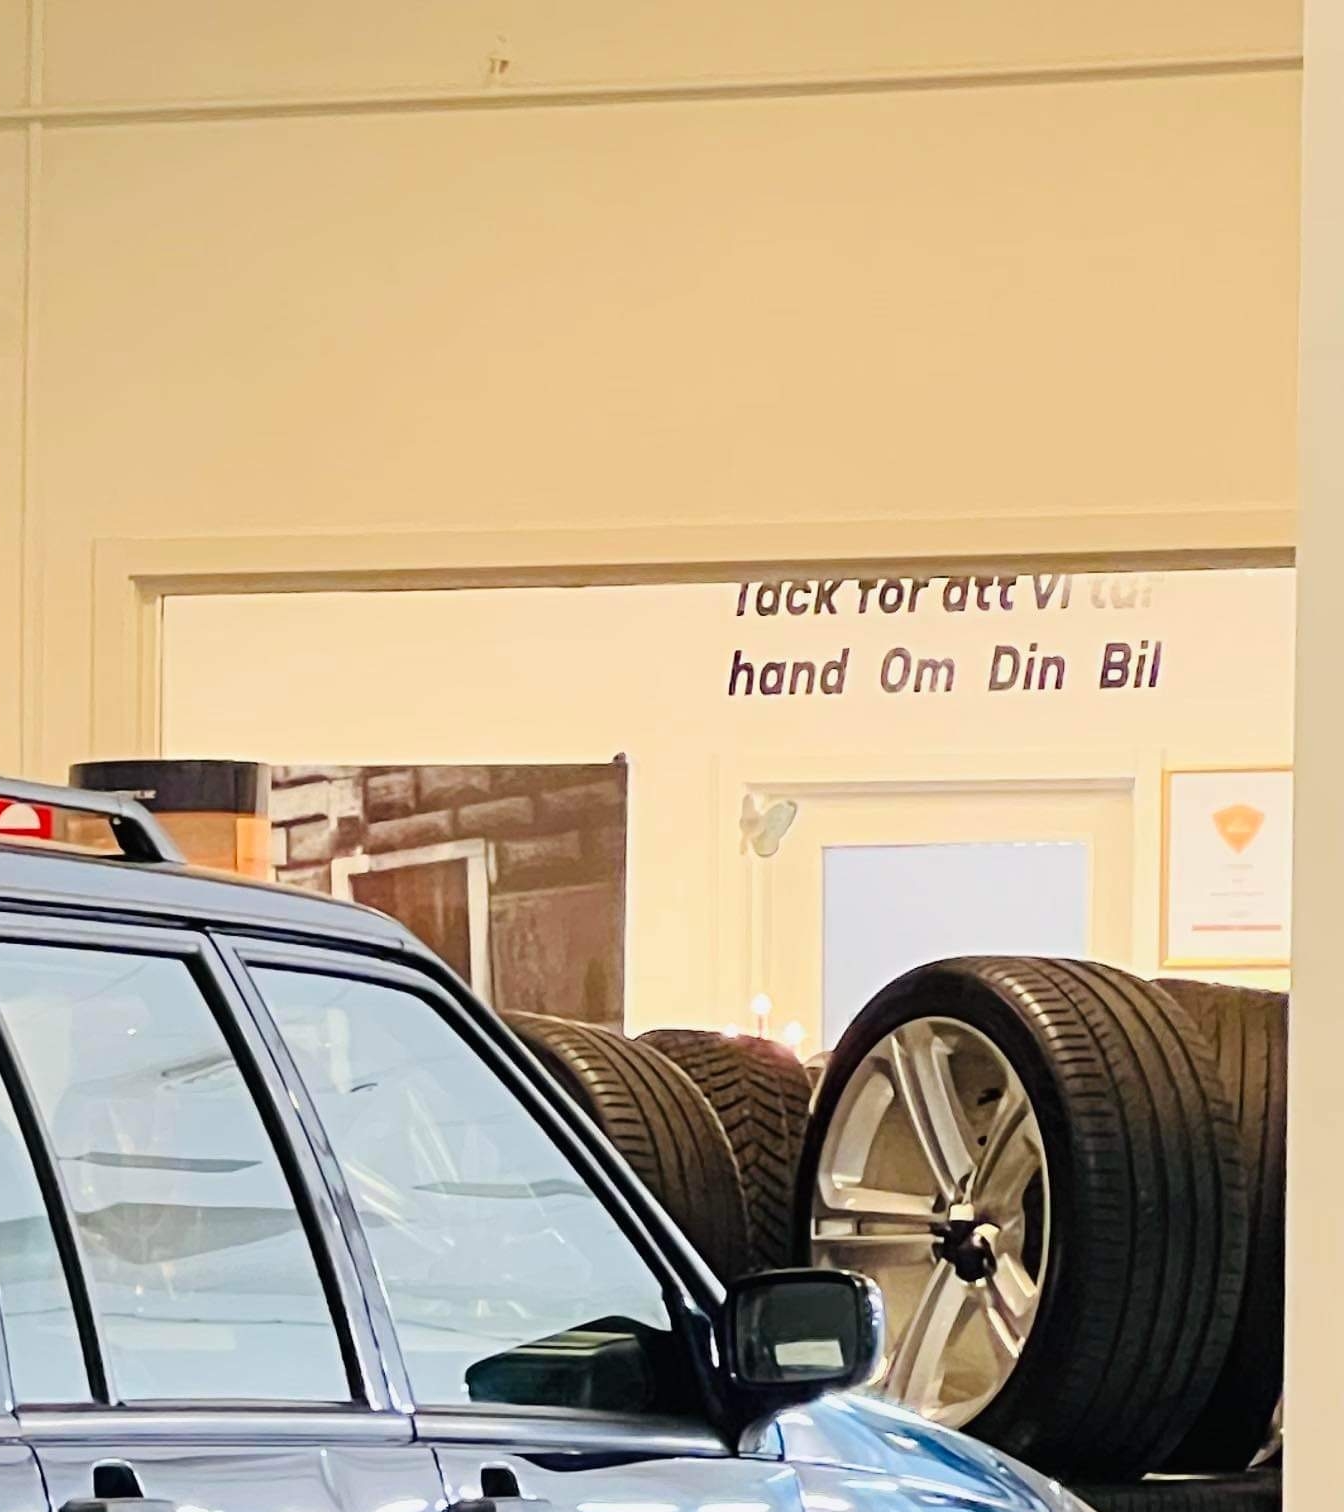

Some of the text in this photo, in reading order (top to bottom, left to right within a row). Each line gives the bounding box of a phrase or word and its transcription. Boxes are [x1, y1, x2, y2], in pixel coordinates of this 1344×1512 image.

[728, 639, 1163, 696] hand Om Din Bil
